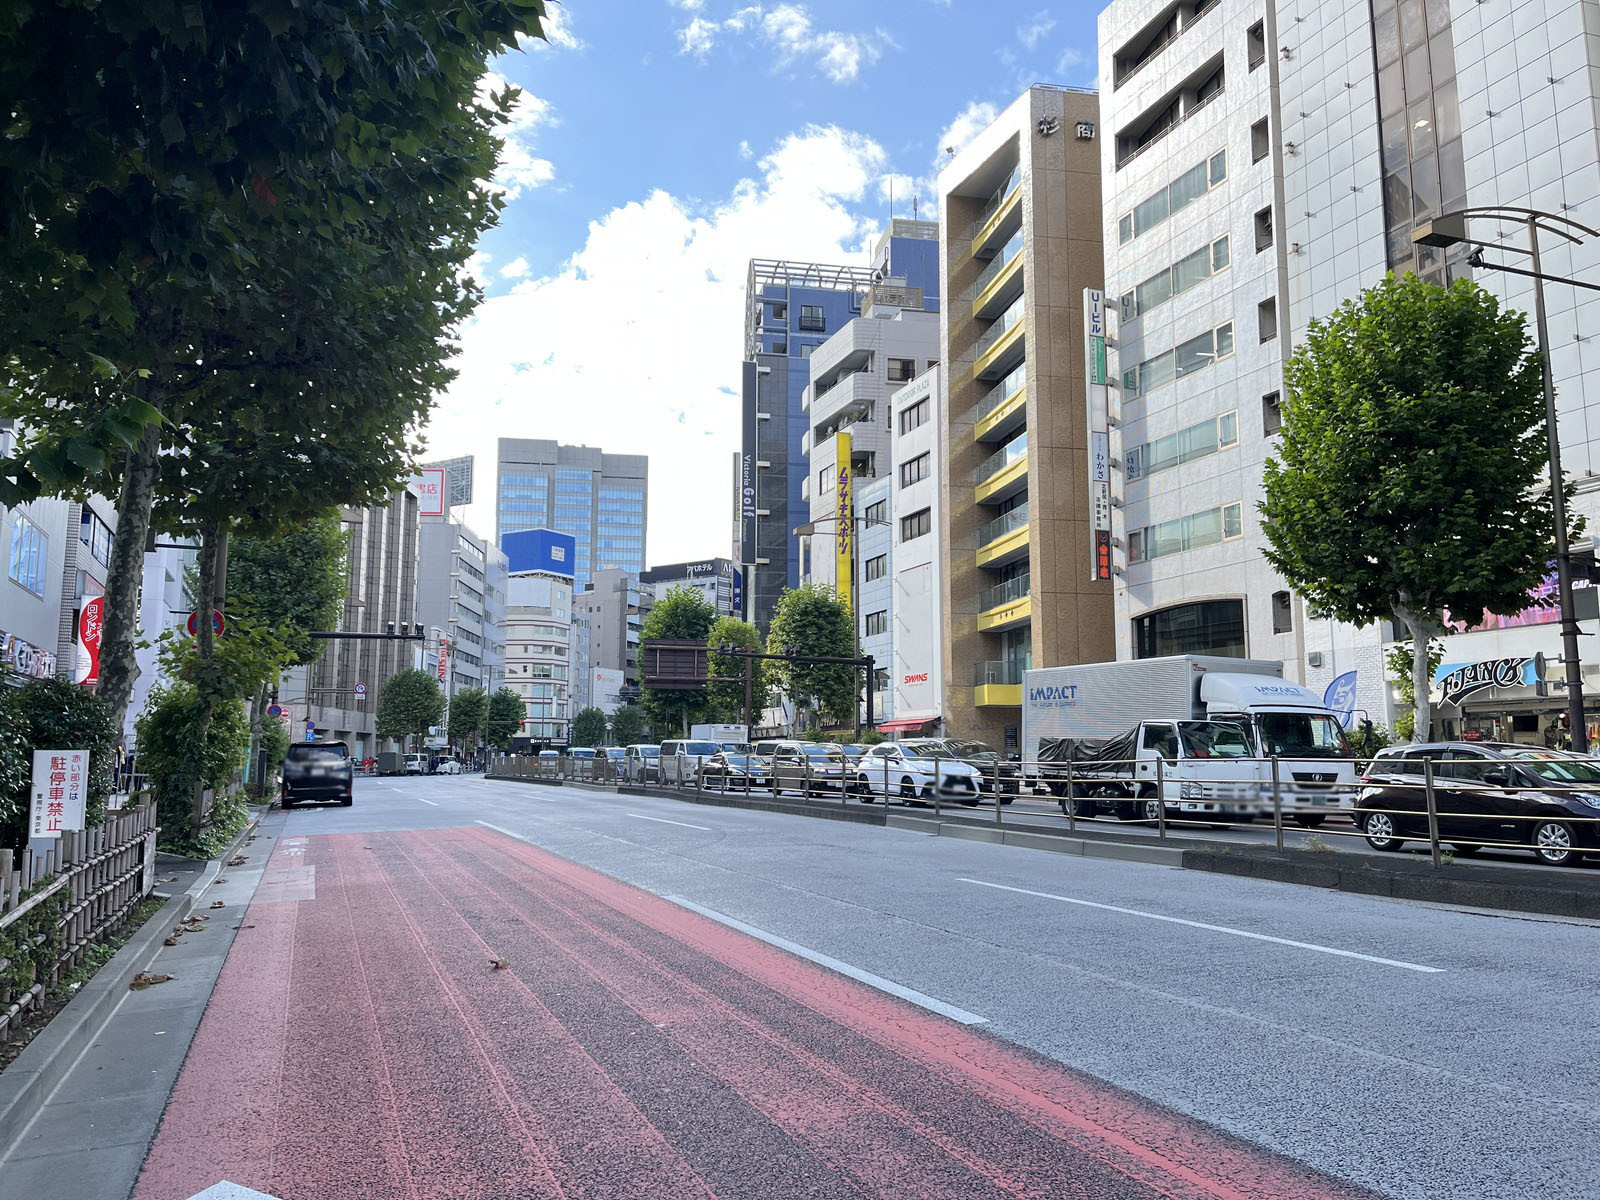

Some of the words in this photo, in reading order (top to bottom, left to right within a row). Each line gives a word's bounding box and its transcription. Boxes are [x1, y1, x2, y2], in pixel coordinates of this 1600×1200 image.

[743, 454, 751, 486] Victoria
[1096, 452, 1105, 480] わかさ
[743, 487, 755, 517] Golf
[838, 466, 849, 555] ムラサキスポーツ
[85, 604, 98, 642] ロンドン
[903, 672, 929, 685] SWANS
[46, 756, 67, 832] 駐停車禁止
[69, 754, 81, 801] 赤い部分は
